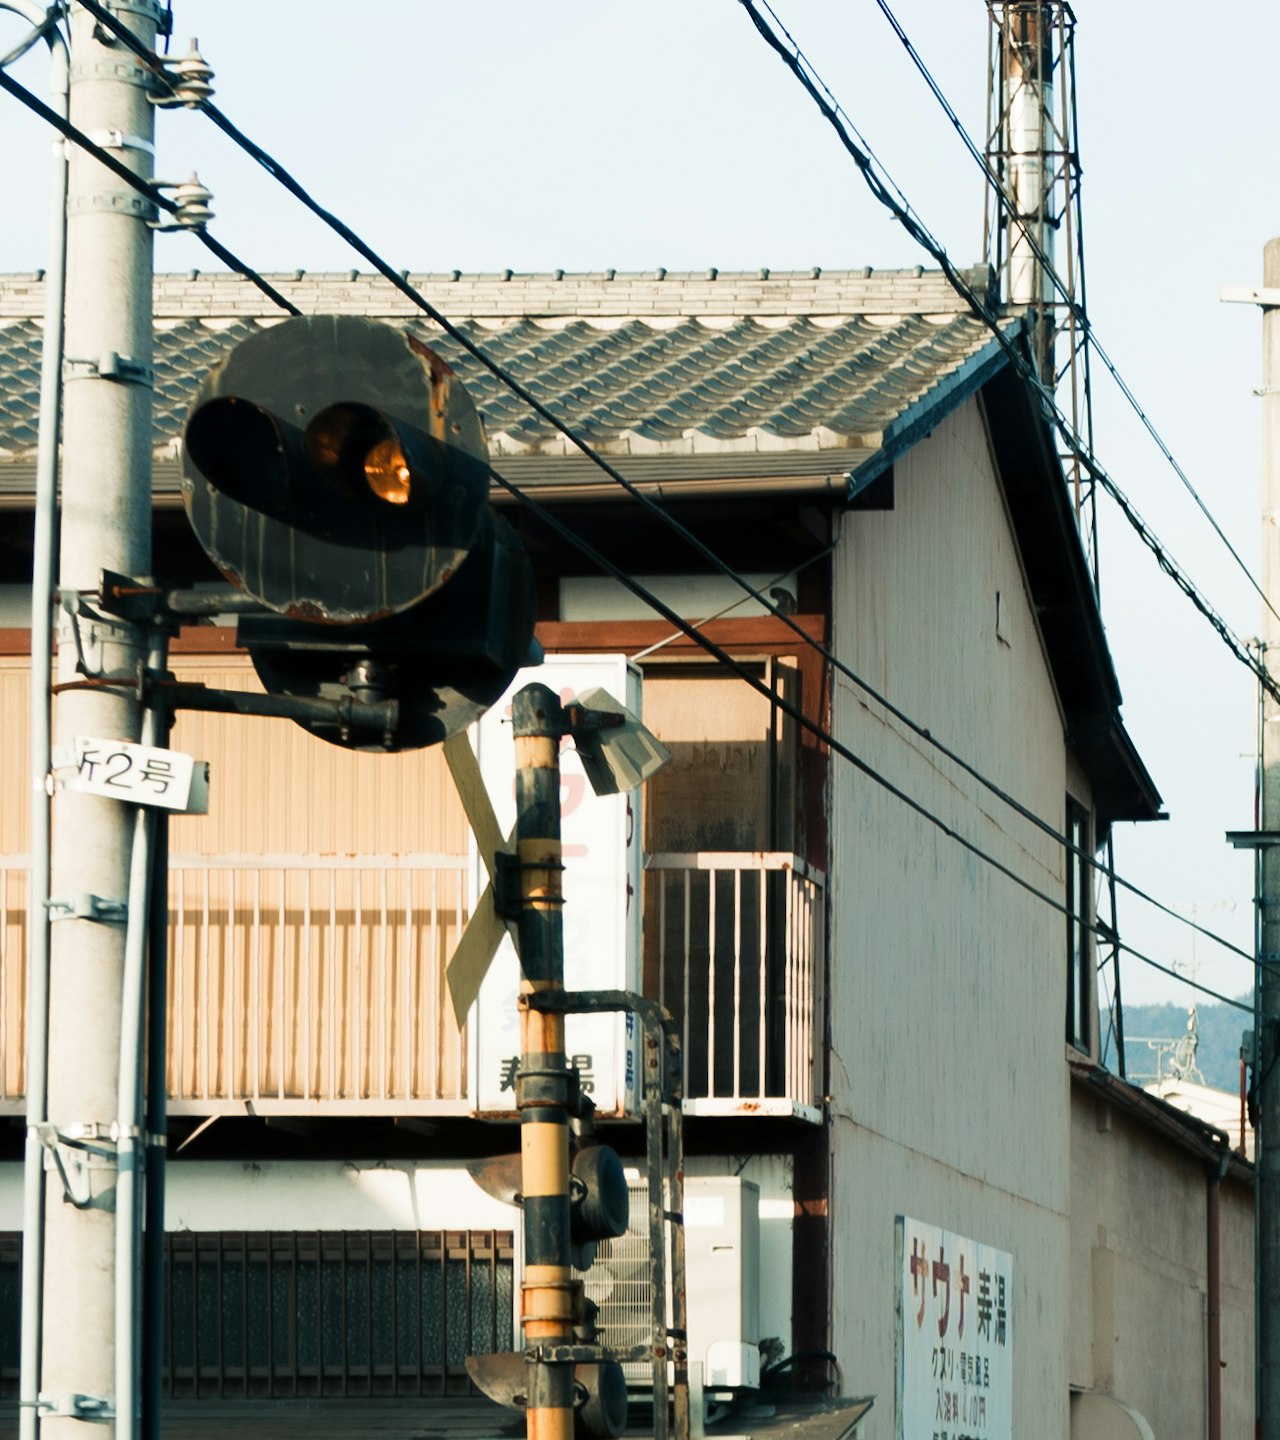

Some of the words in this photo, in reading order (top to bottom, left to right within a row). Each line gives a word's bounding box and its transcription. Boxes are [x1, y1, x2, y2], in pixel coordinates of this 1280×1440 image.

[910, 1237, 971, 1342] サウナ
[977, 1267, 1007, 1347] 寿湯
